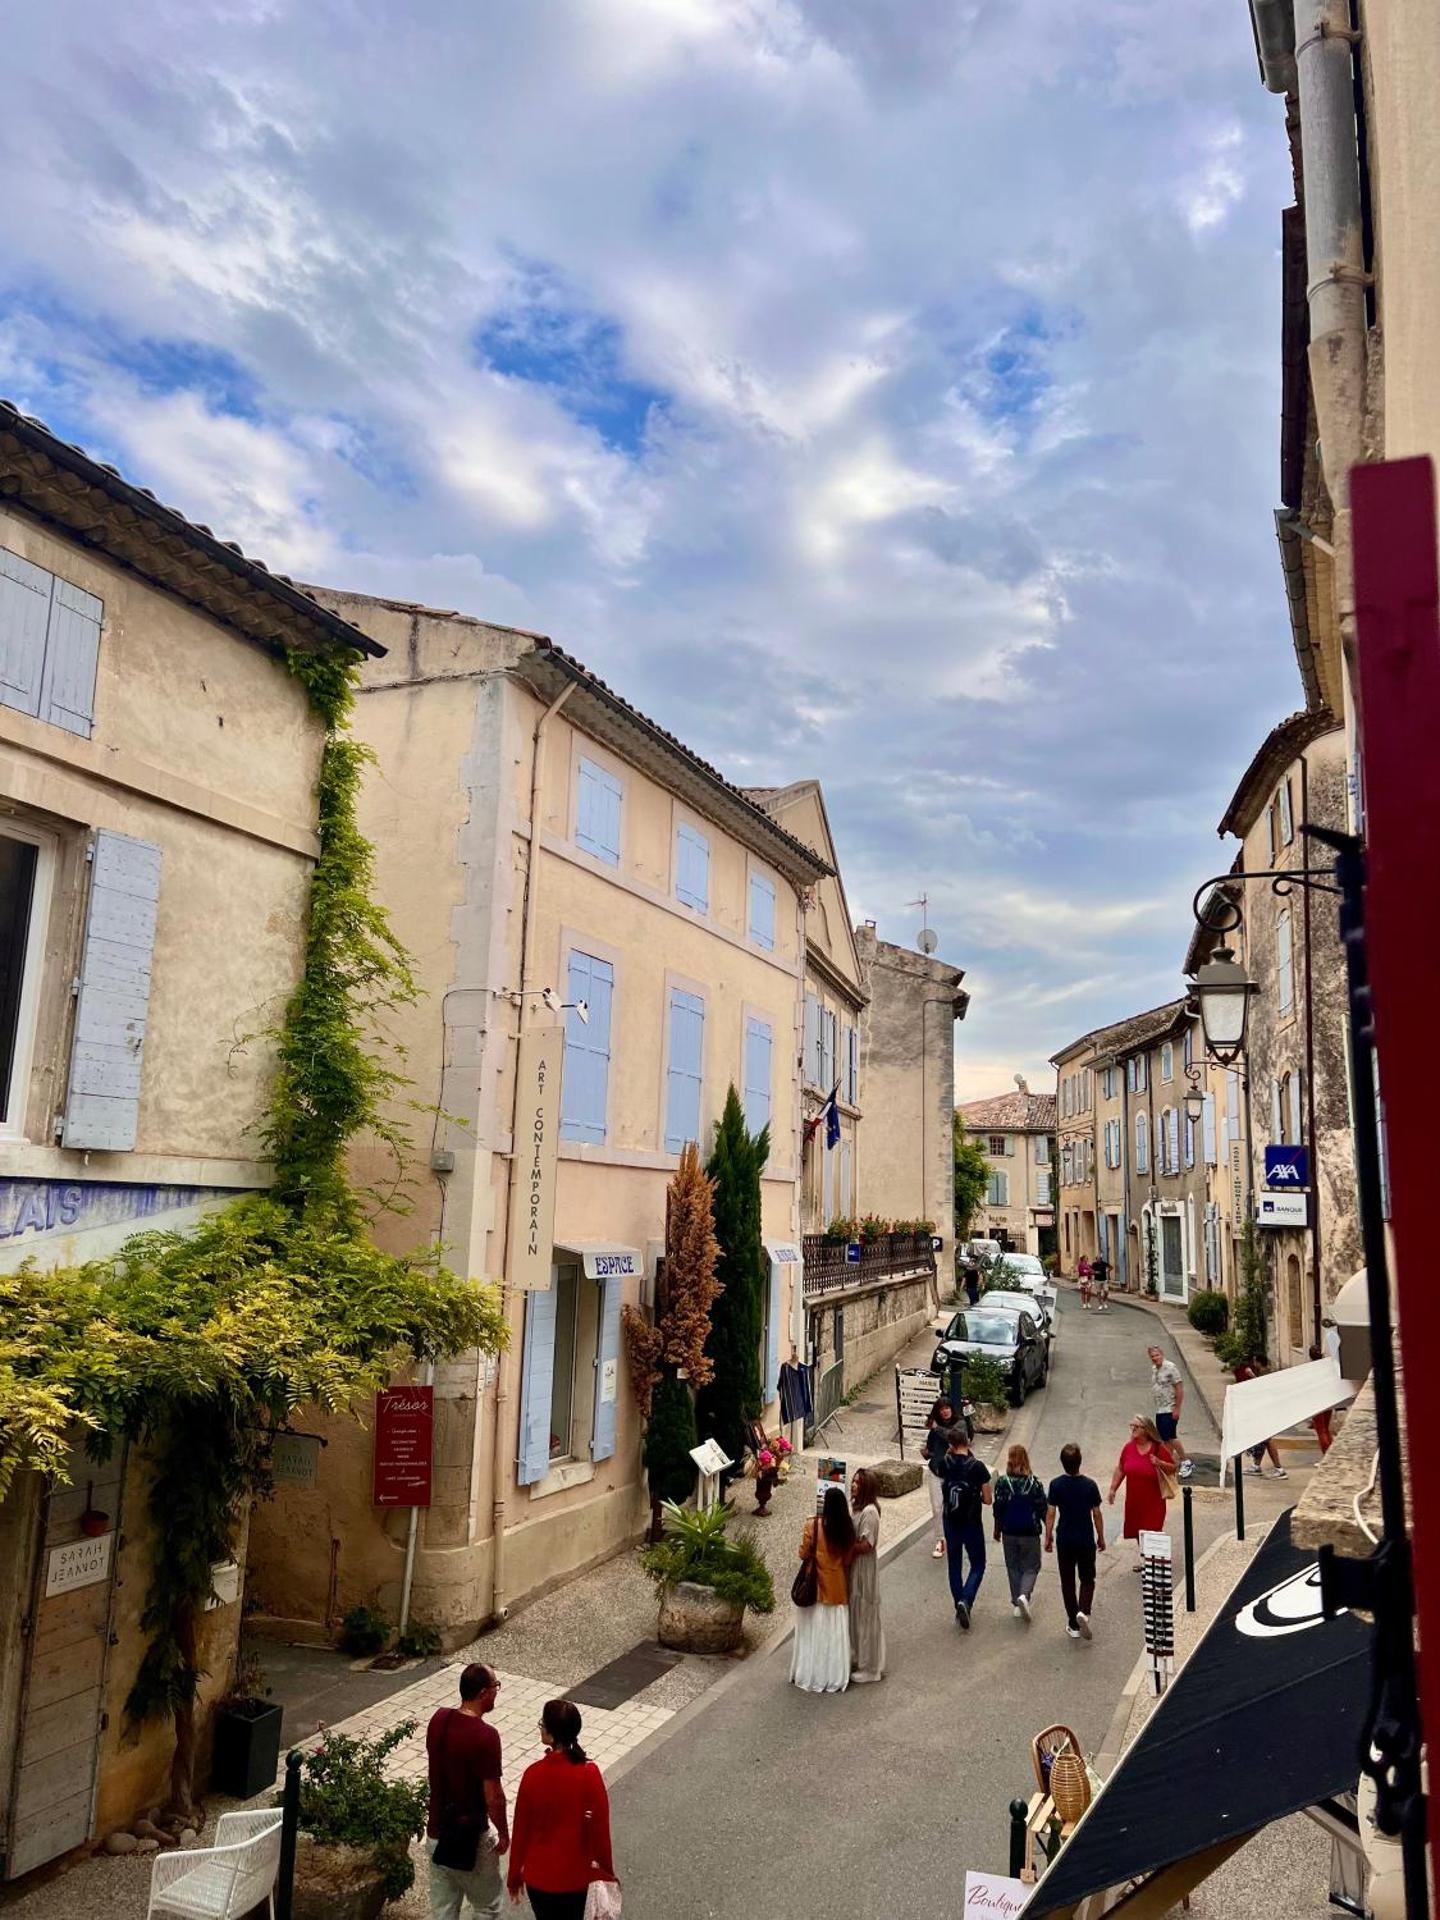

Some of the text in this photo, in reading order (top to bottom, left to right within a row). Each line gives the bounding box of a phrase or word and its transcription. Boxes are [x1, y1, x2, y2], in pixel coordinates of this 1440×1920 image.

[528, 1060, 547, 1256] ART CONTEMPORAIN
[1266, 1164, 1300, 1180] AXA
[933, 1239, 940, 1249] P
[595, 1256, 634, 1275] ESPACE
[61, 1544, 102, 1565] SARAH
[51, 1556, 104, 1583] JEANNOT
